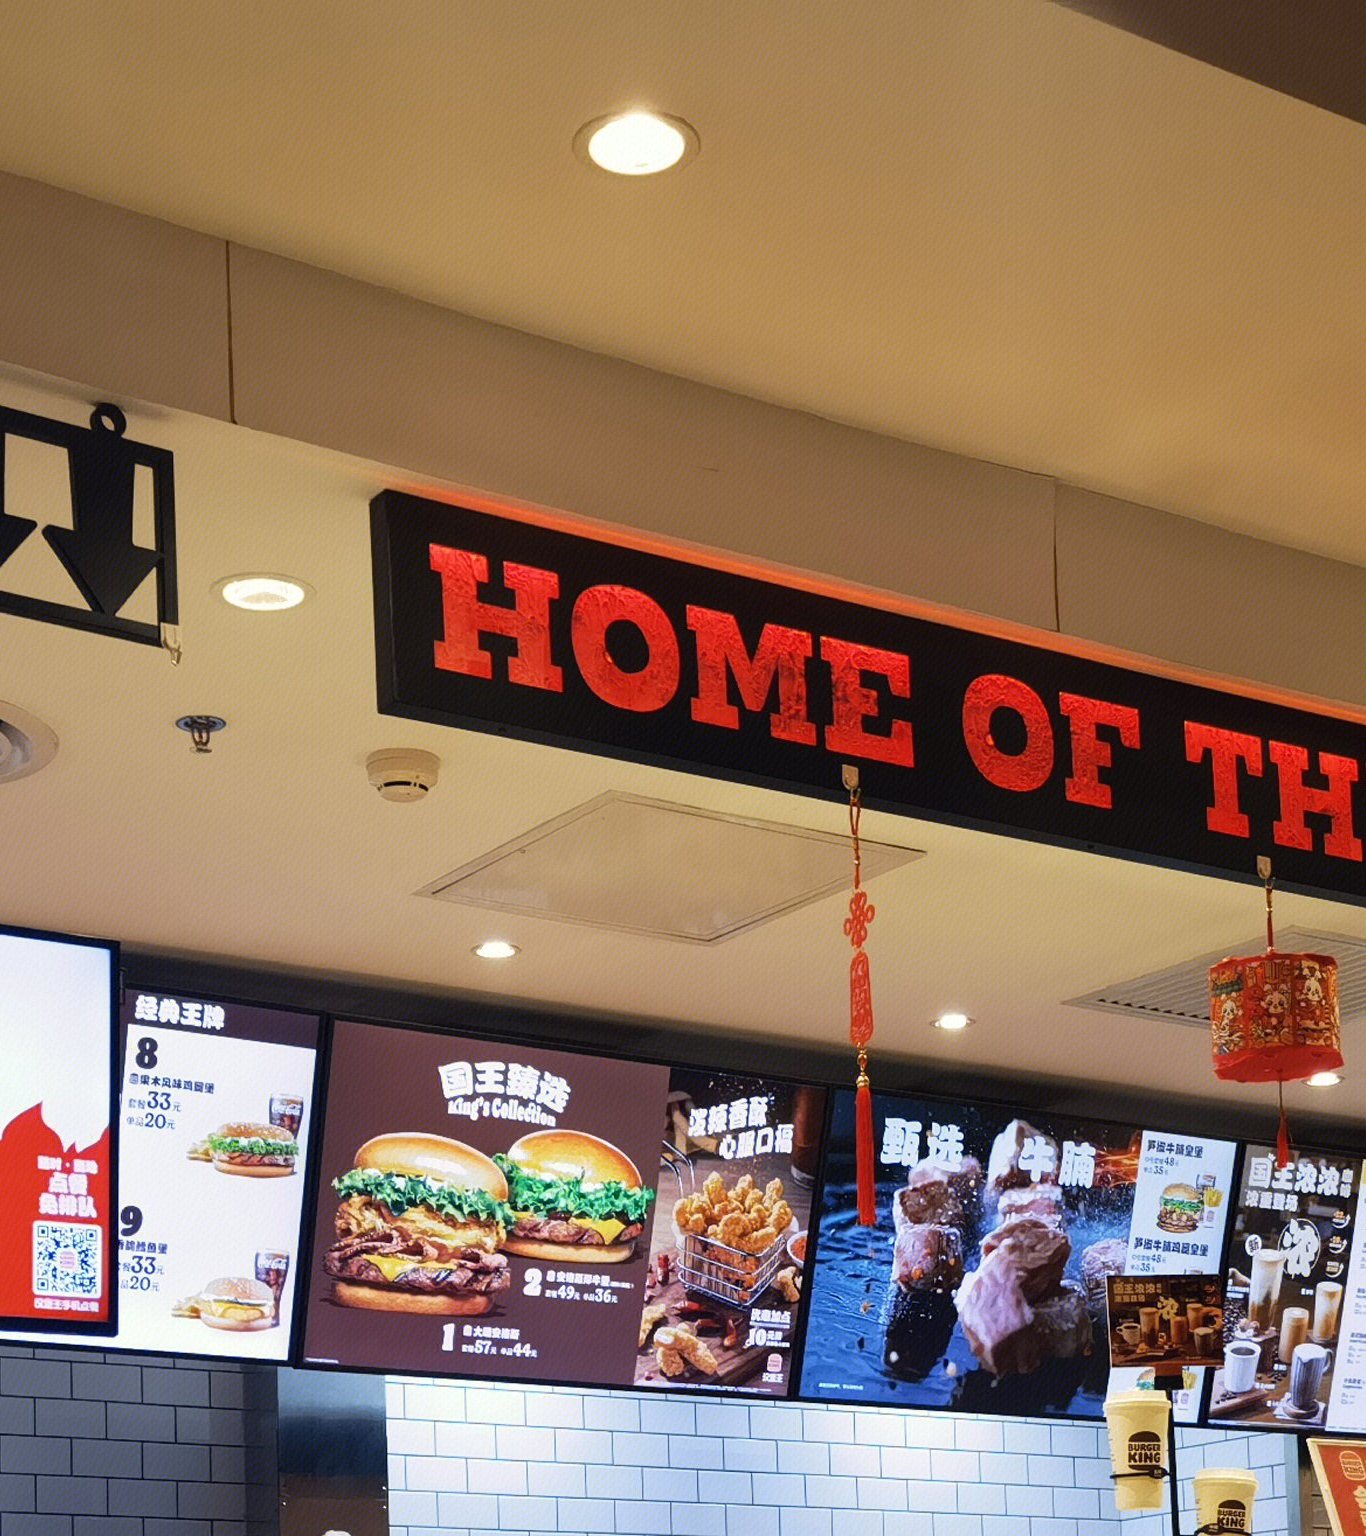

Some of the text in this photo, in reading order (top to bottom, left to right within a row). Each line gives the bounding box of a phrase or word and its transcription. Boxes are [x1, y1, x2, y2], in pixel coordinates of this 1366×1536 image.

[428, 542, 915, 768] HOME
[961, 672, 1141, 810] OF
[134, 994, 226, 1030] 经典王牌
[134, 1036, 159, 1071] 8
[437, 1061, 572, 1114] 国王臻选
[447, 1097, 558, 1128] King's Collection
[880, 1117, 965, 1173] 甄选
[1018, 1135, 1097, 1189] 牛腩
[119, 1205, 144, 1237] 9
[522, 1268, 543, 1297] 2
[441, 1322, 457, 1352] 1
[1127, 1442, 1162, 1452] BURGER
[1127, 1451, 1162, 1464] KING
[1217, 1509, 1246, 1518] BURGER
[1217, 1517, 1246, 1529] KING
